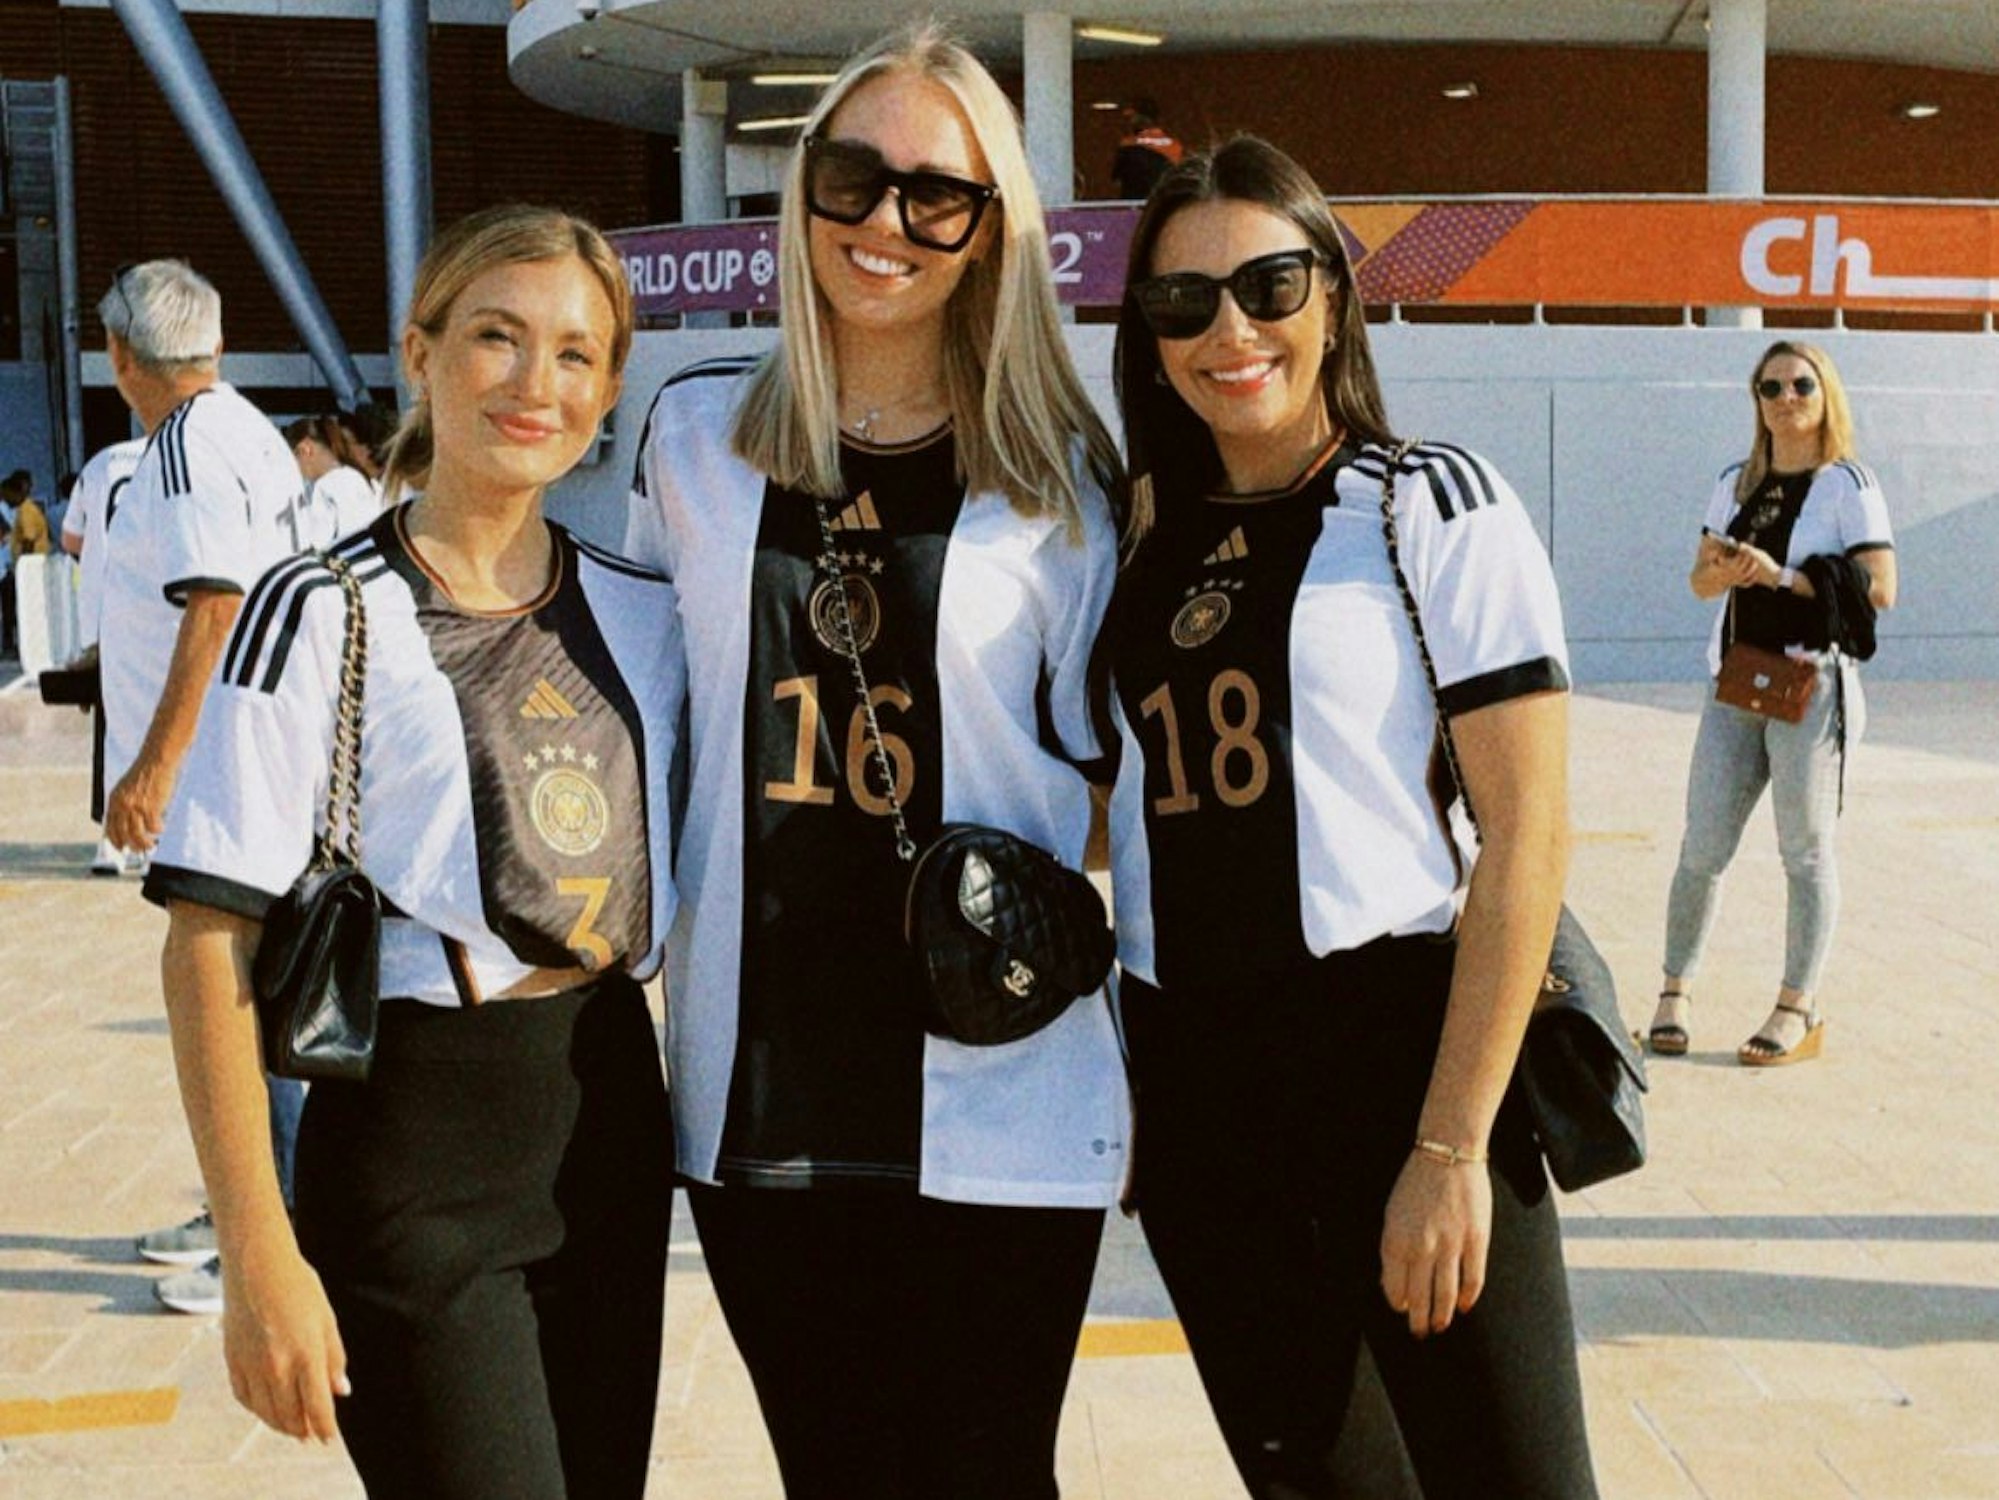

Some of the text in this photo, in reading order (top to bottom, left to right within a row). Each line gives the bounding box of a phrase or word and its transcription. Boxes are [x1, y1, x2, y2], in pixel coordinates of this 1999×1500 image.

[682, 249, 744, 294] CUP
[764, 674, 915, 816] 16
[1140, 669, 1270, 816] 18
